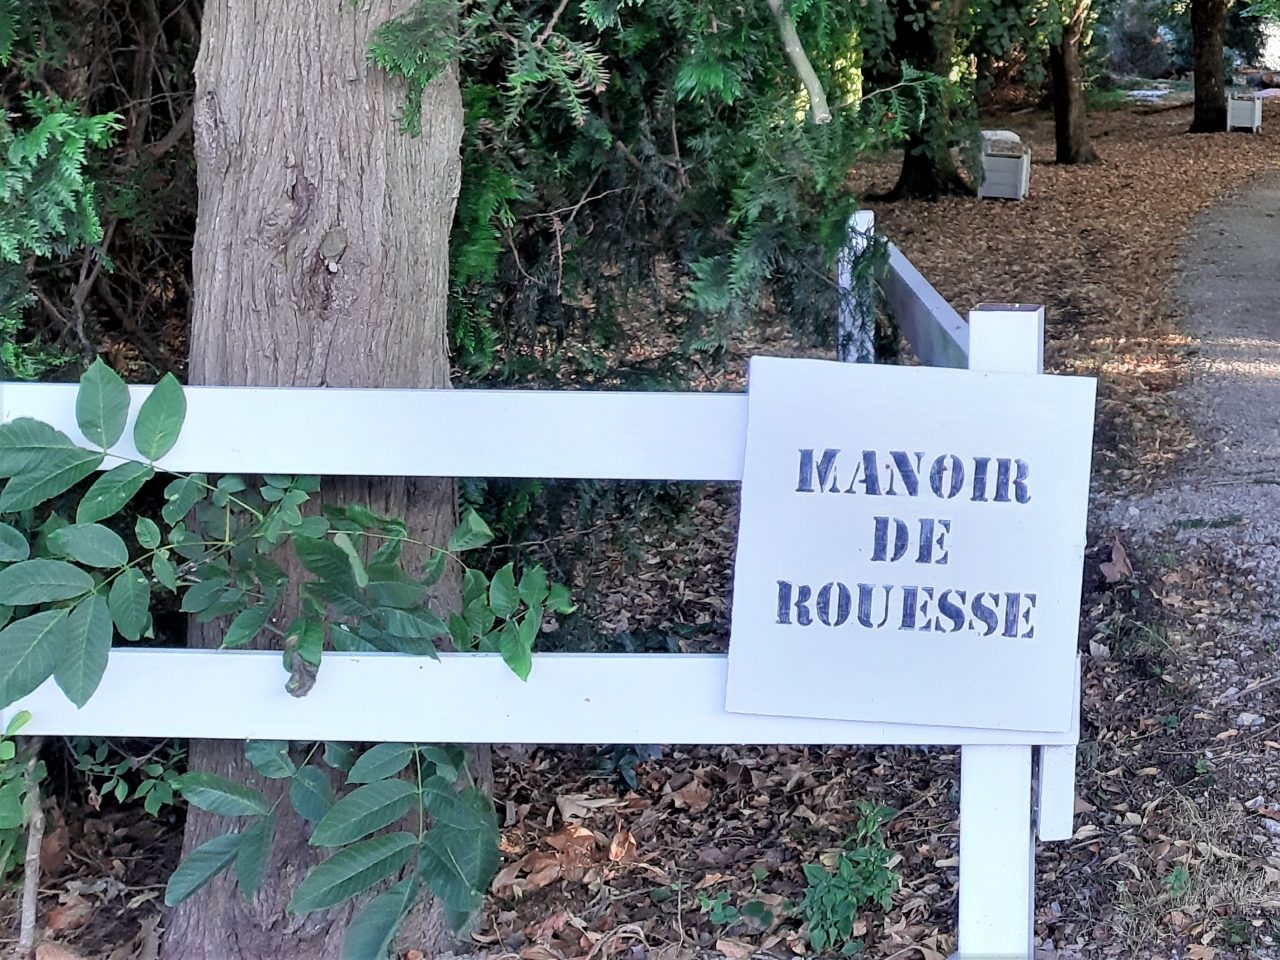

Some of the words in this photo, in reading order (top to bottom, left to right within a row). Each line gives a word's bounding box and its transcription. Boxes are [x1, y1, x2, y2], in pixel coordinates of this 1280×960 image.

[795, 447, 1032, 505] MANOIR
[869, 516, 951, 565] DE
[775, 580, 1038, 640] ROUESSE
